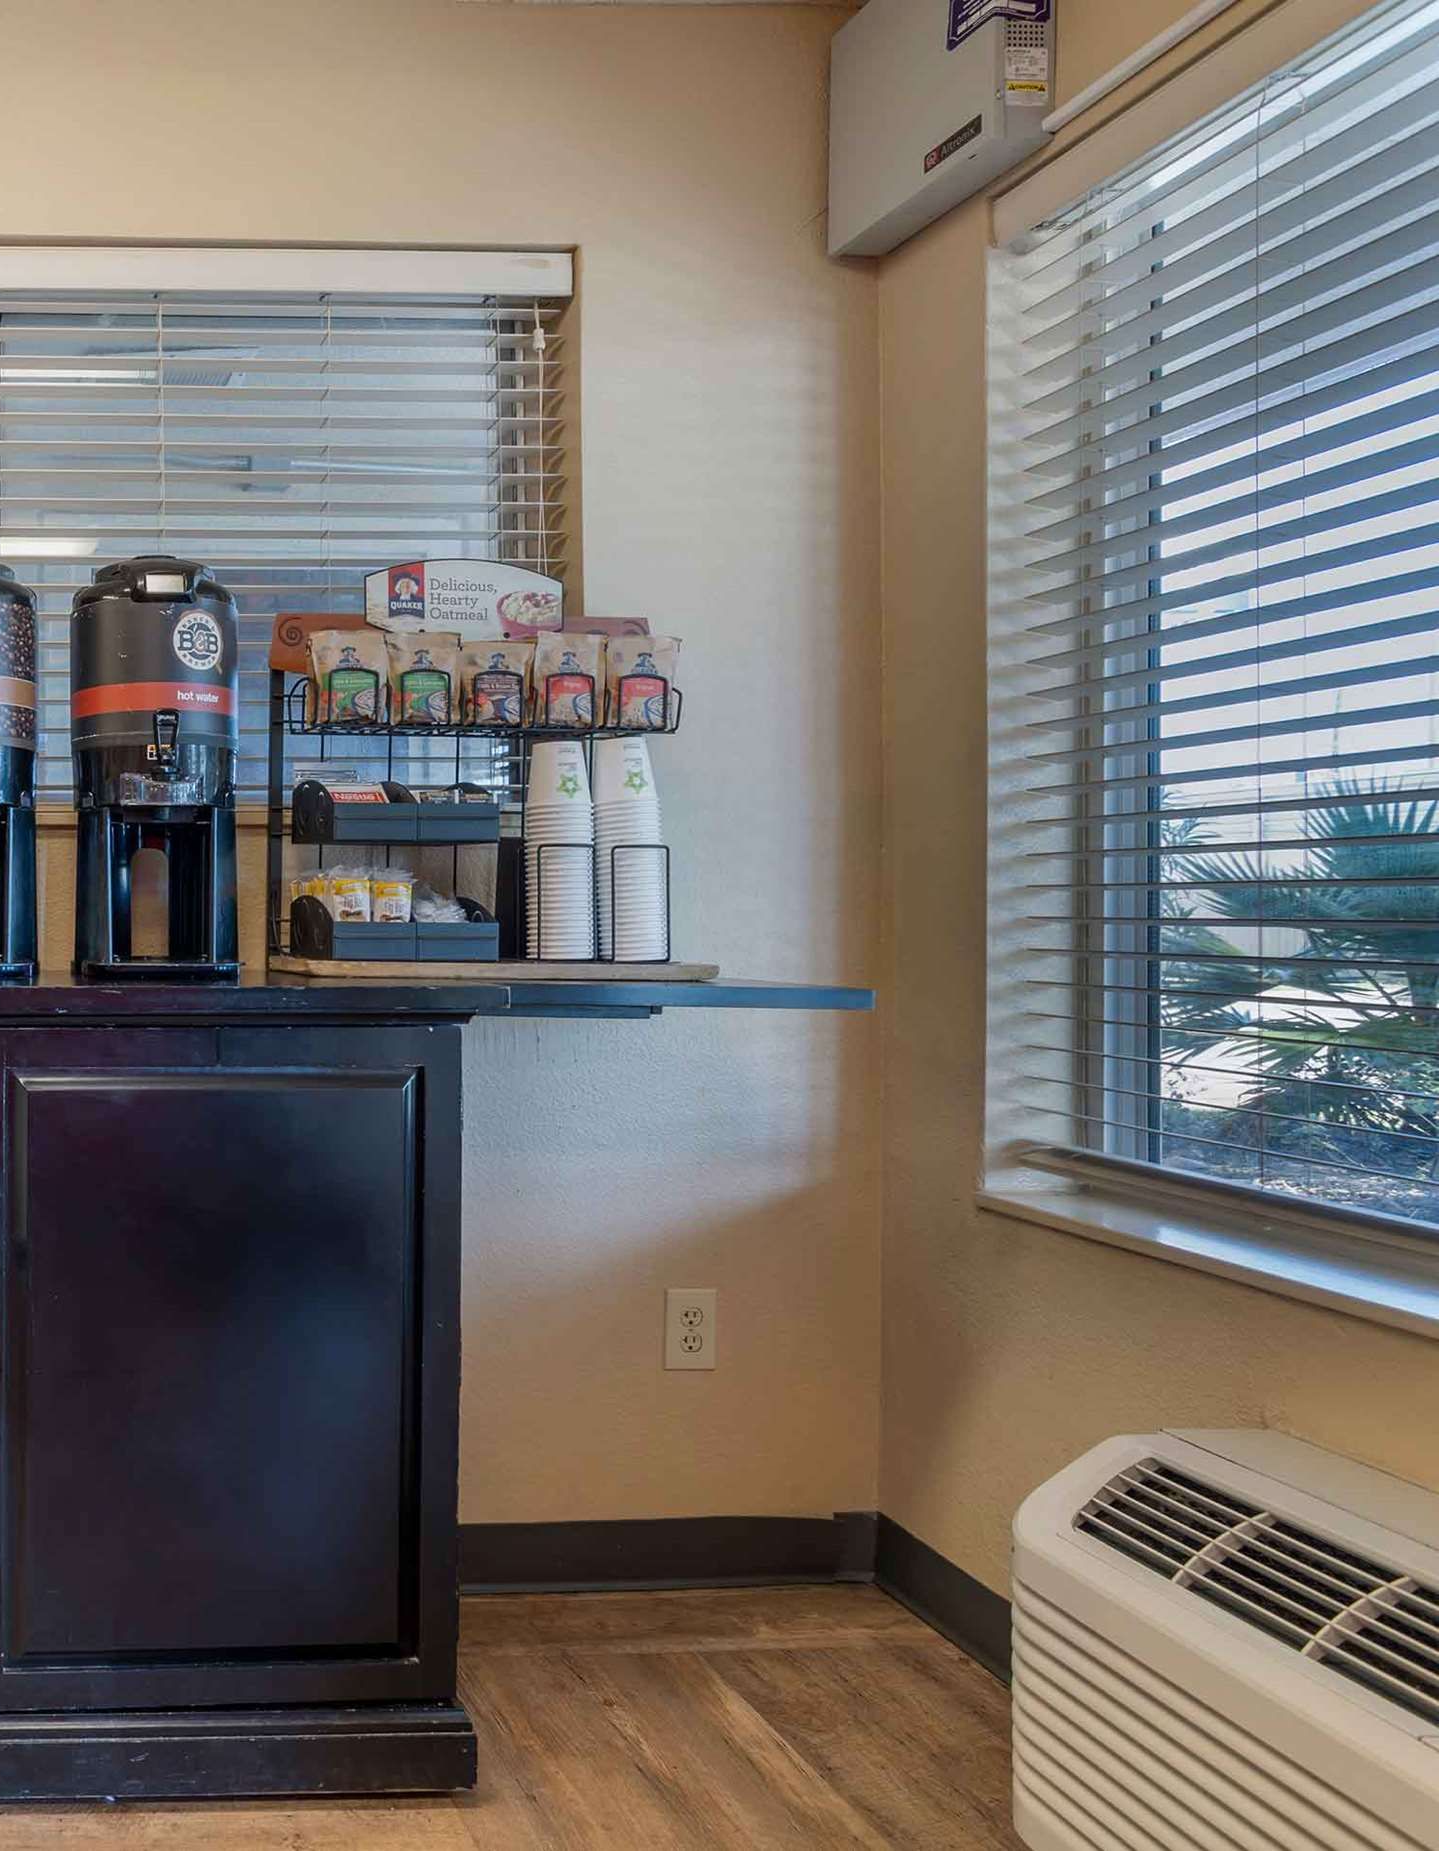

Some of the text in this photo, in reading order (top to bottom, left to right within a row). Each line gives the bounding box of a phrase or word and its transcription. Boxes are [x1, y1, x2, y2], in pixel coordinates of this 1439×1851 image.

[430, 578, 497, 596] Delicious,
[391, 600, 423, 610] QUAKER
[430, 592, 479, 609] Hearty
[430, 607, 488, 620] Oatmeal
[177, 629, 219, 655] B&B
[177, 690, 219, 703] hot water
